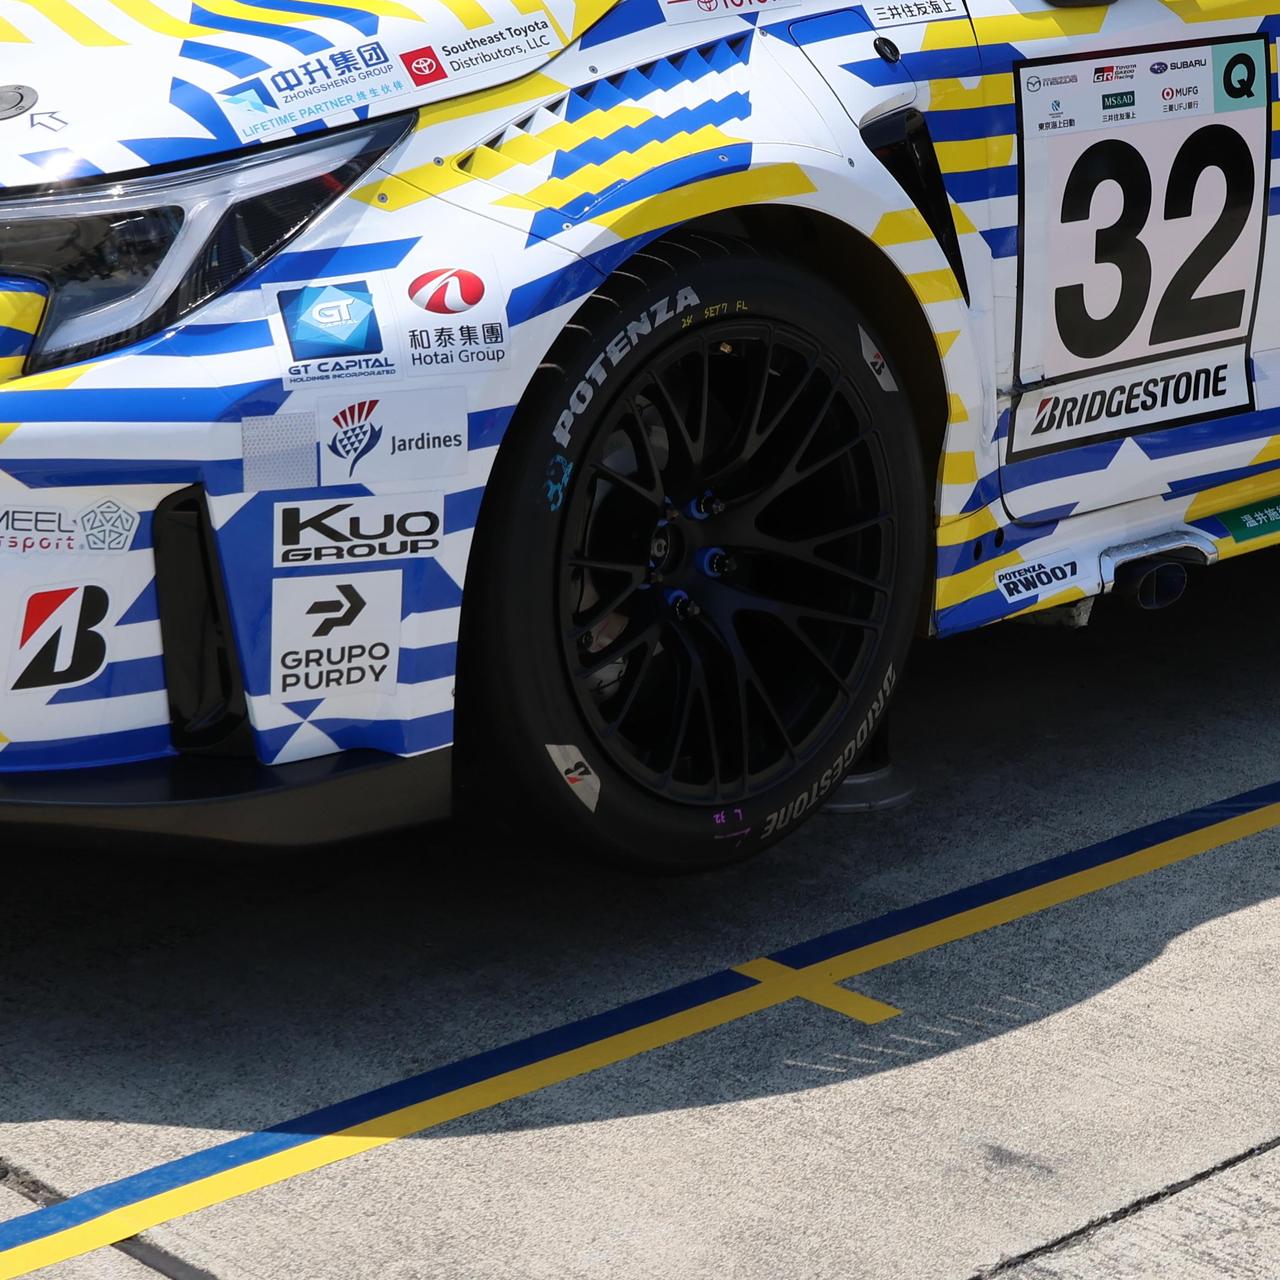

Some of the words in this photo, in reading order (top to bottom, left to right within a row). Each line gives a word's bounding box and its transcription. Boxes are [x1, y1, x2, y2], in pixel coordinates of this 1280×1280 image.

[441, 28, 508, 58] Southeast
[505, 17, 549, 40] Toyota
[270, 41, 390, 94] 中升集团
[450, 43, 528, 74] Distributors,
[525, 33, 551, 52] LLC
[1169, 58, 1207, 71] SUBARU
[282, 75, 357, 105] ZHONGSHENG
[357, 63, 395, 83] GROUP
[356, 78, 406, 103] 终生伙伴
[1222, 52, 1257, 100] Q
[1104, 94, 1134, 108] MS&AD
[1175, 86, 1199, 98] MUFG
[241, 110, 299, 139] LIFETIME
[298, 94, 357, 119] PARTNER
[1102, 111, 1137, 124] 三井住友海上
[1054, 123, 1256, 359] 32
[310, 297, 356, 325] GT
[408, 321, 505, 351] 和泰集團
[288, 363, 312, 376] GT
[317, 356, 396, 373] CAPITAL
[411, 350, 455, 366] Hotai
[458, 348, 506, 365] Group
[552, 285, 701, 449] POTENZA
[289, 374, 331, 384] HOLDINGS
[331, 368, 397, 381] INCORPORATED
[1030, 363, 1229, 436] BRIDGESTONE
[391, 432, 463, 456] Jardines
[281, 538, 440, 563] GROUP
[997, 562, 1047, 584] POTENZA
[1003, 560, 1079, 599] RW007
[281, 641, 391, 671] GRUPO
[281, 664, 388, 694] PURDY
[759, 659, 898, 840] BRIDGESTONE
